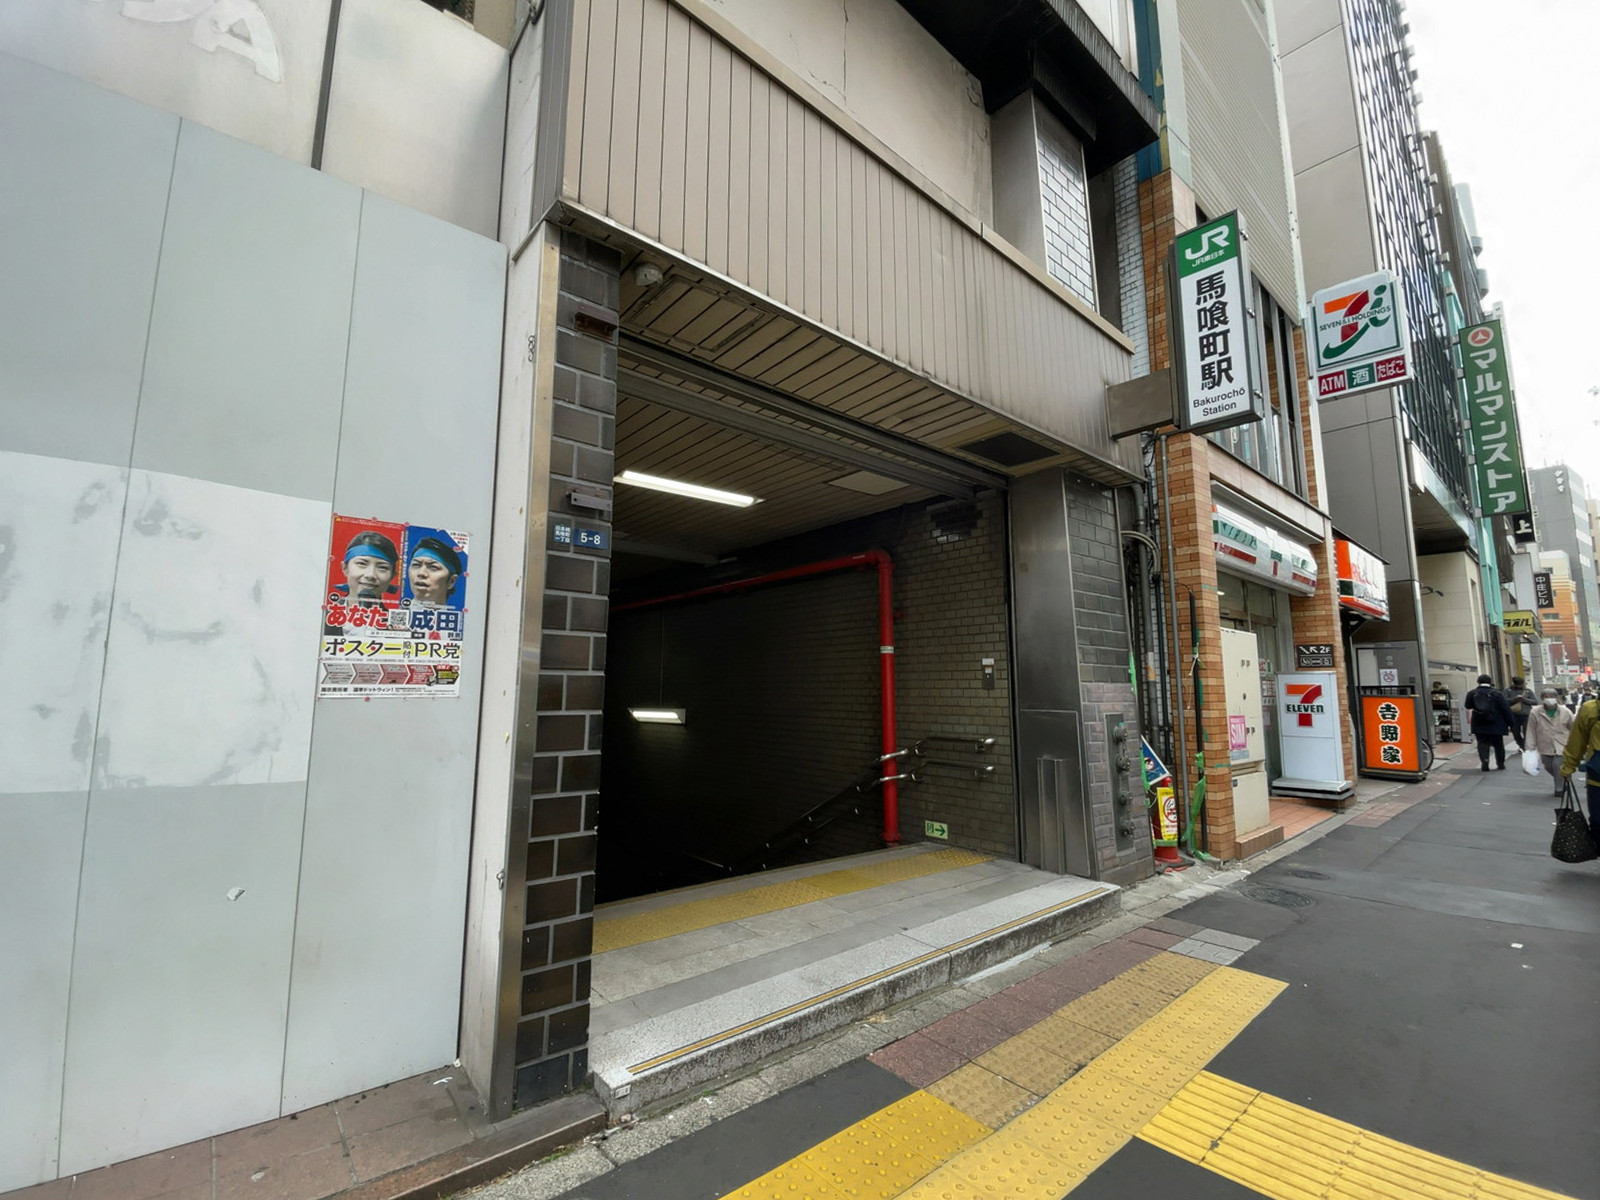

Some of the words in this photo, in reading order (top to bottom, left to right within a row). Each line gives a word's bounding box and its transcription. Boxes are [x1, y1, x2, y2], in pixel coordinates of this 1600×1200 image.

[1185, 225, 1230, 260] JR
[1352, 305, 1391, 323] HOLDINGS
[1195, 270, 1234, 391] 馬喰町駅
[1352, 368, 1370, 386] 酒
[1377, 360, 1404, 378] たばこ
[1321, 374, 1345, 393] ATM
[1202, 401, 1237, 417] Station
[1469, 348, 1517, 513] マルマンストア
[581, 532, 601, 545] 5-8
[326, 604, 388, 628] あなた
[410, 610, 459, 631] 成田
[1230, 723, 1246, 744] SIM
